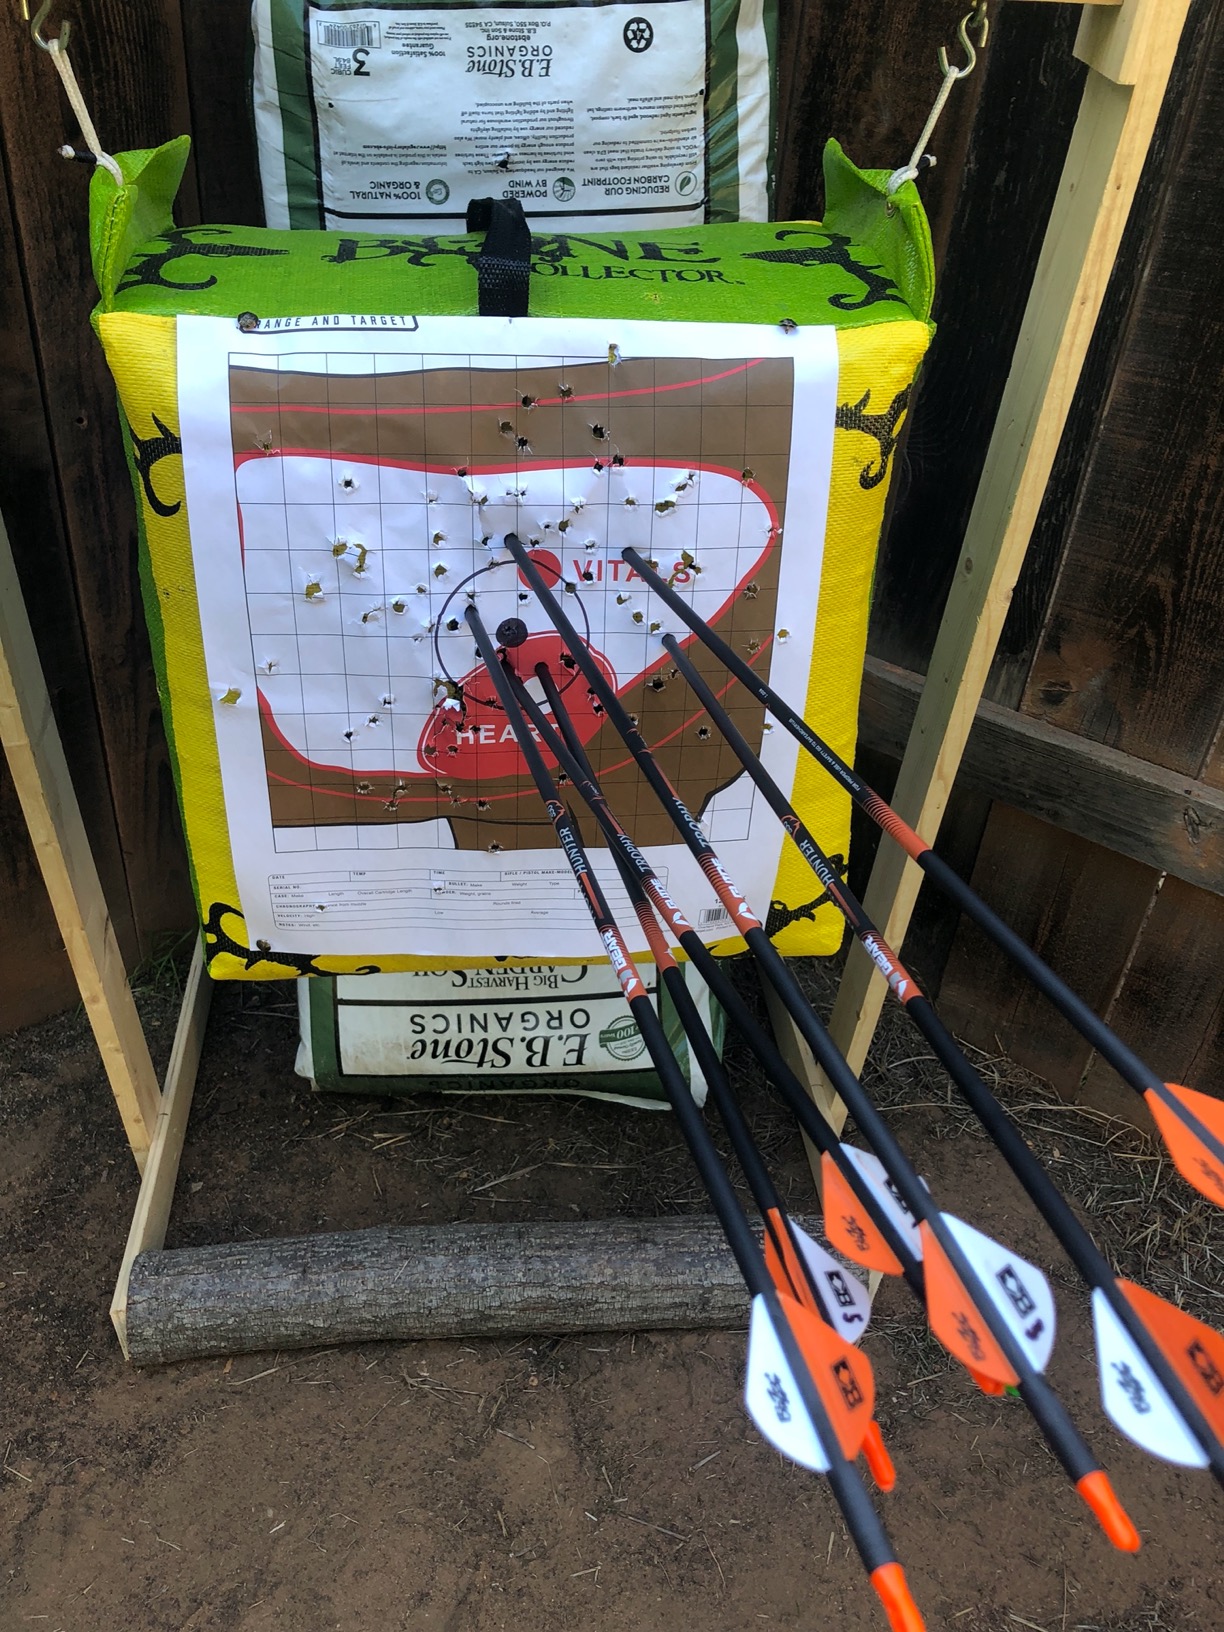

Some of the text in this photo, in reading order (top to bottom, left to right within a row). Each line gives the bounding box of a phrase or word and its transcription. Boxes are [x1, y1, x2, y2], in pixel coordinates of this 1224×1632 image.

[466, 45, 553, 58] ORGANICS
[352, 49, 370, 76] 3
[370, 181, 420, 189] & ORGANIC
[508, 180, 532, 188] WIND
[582, 175, 670, 186] CARBON FOOTPRINT
[350, 191, 421, 200] 100% NATURAL
[502, 190, 548, 198] POWERED
[605, 185, 670, 196] REDUCING OUR
[531, 262, 736, 284] OLLECTOR
[312, 315, 340, 326] AND
[350, 315, 406, 326] TARGET
[560, 826, 588, 874] HUNTER
[618, 834, 652, 872] TROPHY
[800, 838, 835, 886] HUNTER
[602, 929, 627, 972] GEAR
[862, 935, 893, 974] GEAR
[409, 1008, 590, 1034] ORGANICS
[616, 1025, 634, 1039] 100
